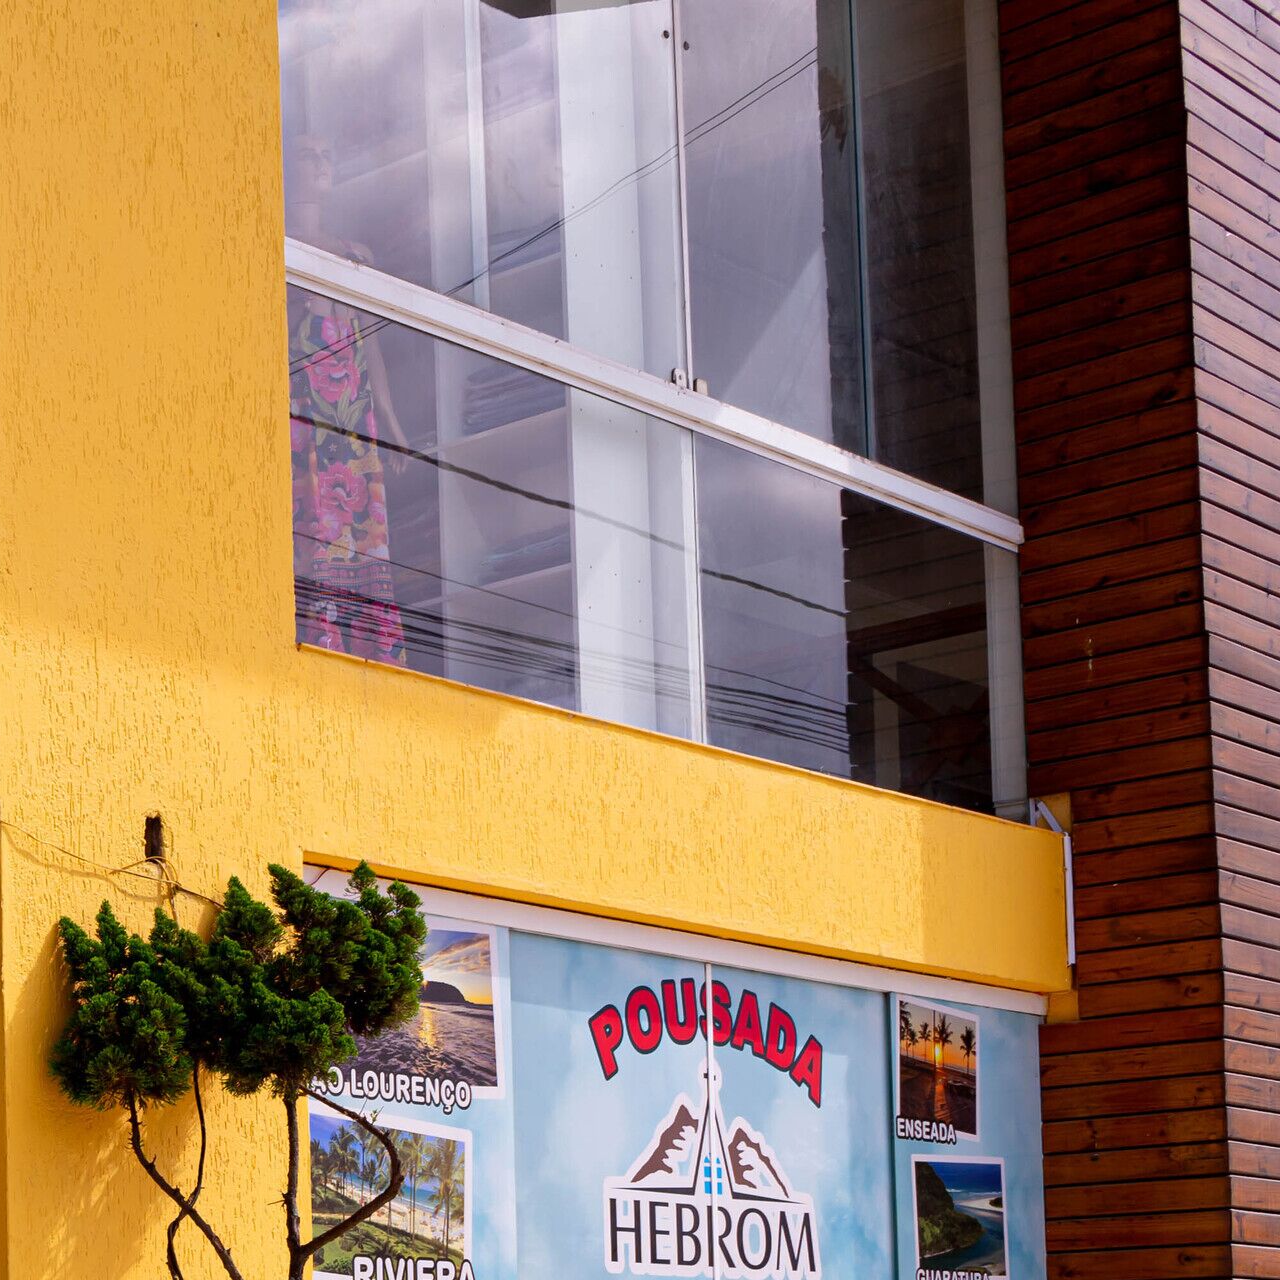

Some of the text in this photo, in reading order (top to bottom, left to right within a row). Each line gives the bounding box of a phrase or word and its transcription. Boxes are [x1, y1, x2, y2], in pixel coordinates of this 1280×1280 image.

[588, 978, 823, 1108] POUSADA
[350, 1067, 472, 1114] LOURENÇO
[896, 1116, 956, 1144] ENSEADA
[608, 1198, 817, 1273] HEBROM
